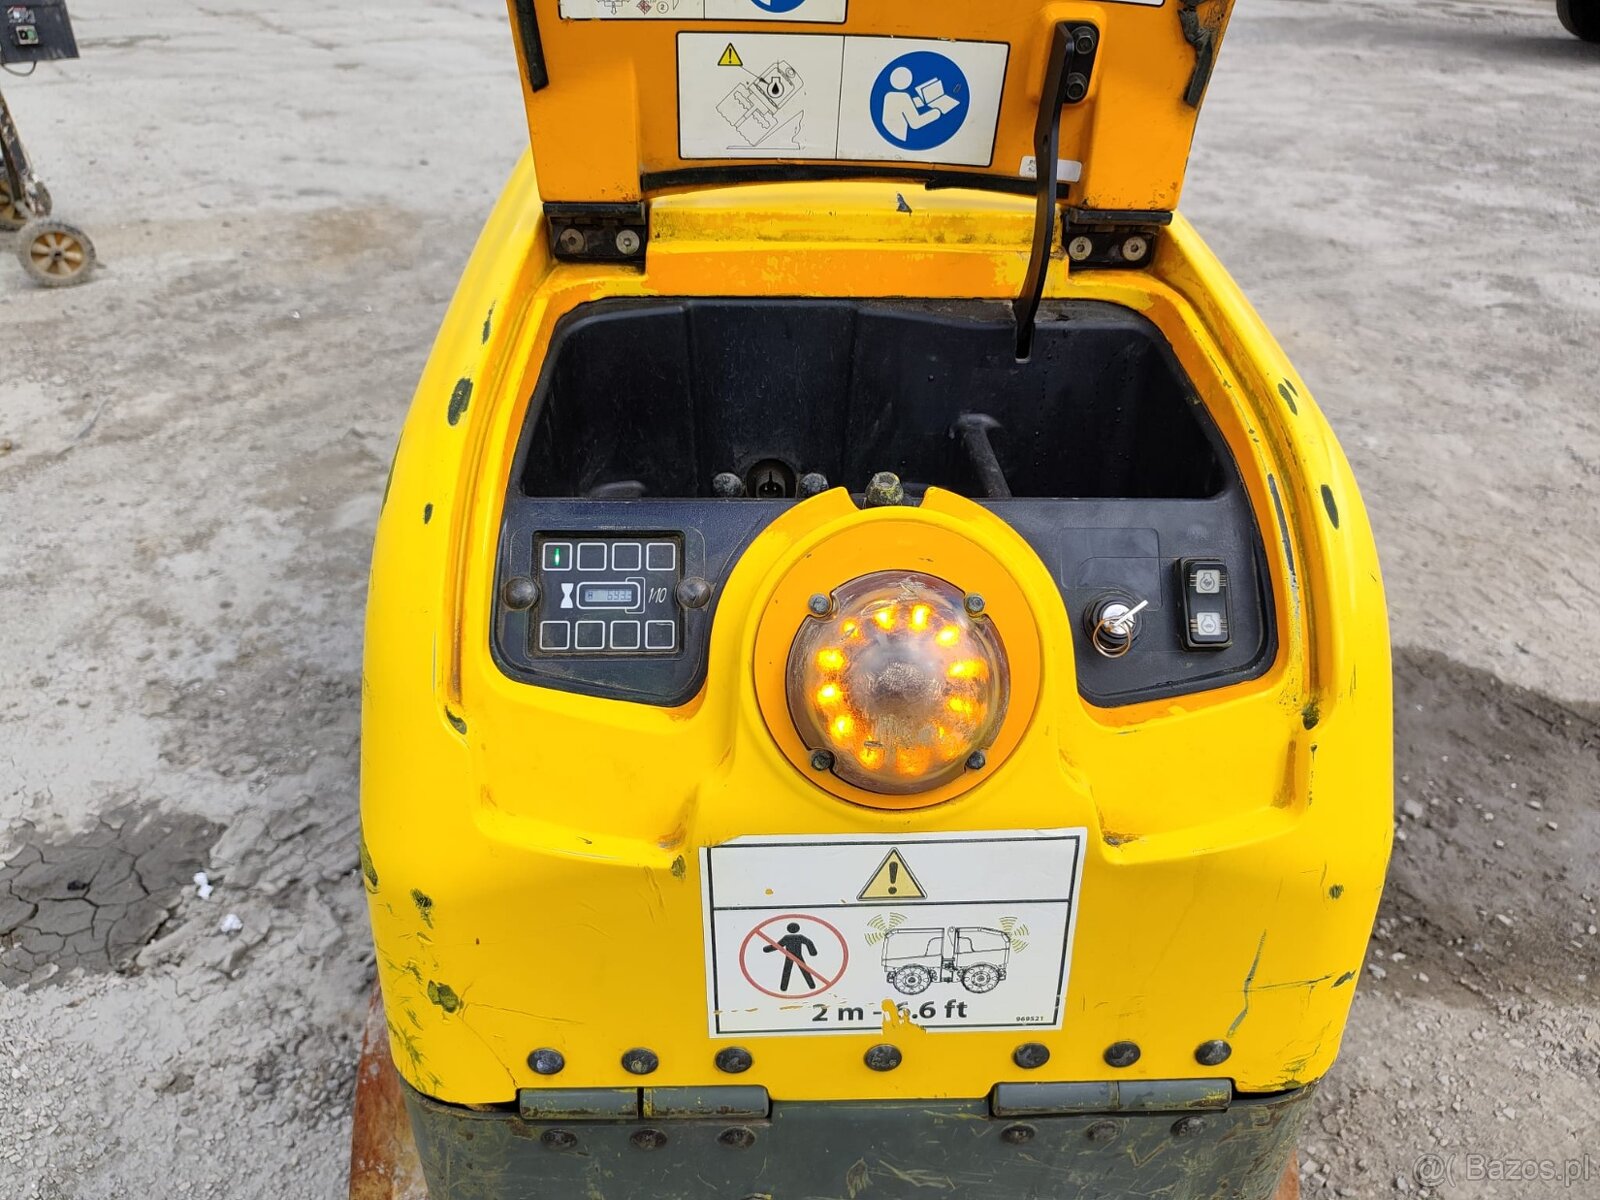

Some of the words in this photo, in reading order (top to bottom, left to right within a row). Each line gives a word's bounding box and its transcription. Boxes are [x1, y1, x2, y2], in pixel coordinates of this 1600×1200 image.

[811, 1003, 828, 1021] 2
[838, 1006, 864, 1021] m
[944, 999, 968, 1018] ft
